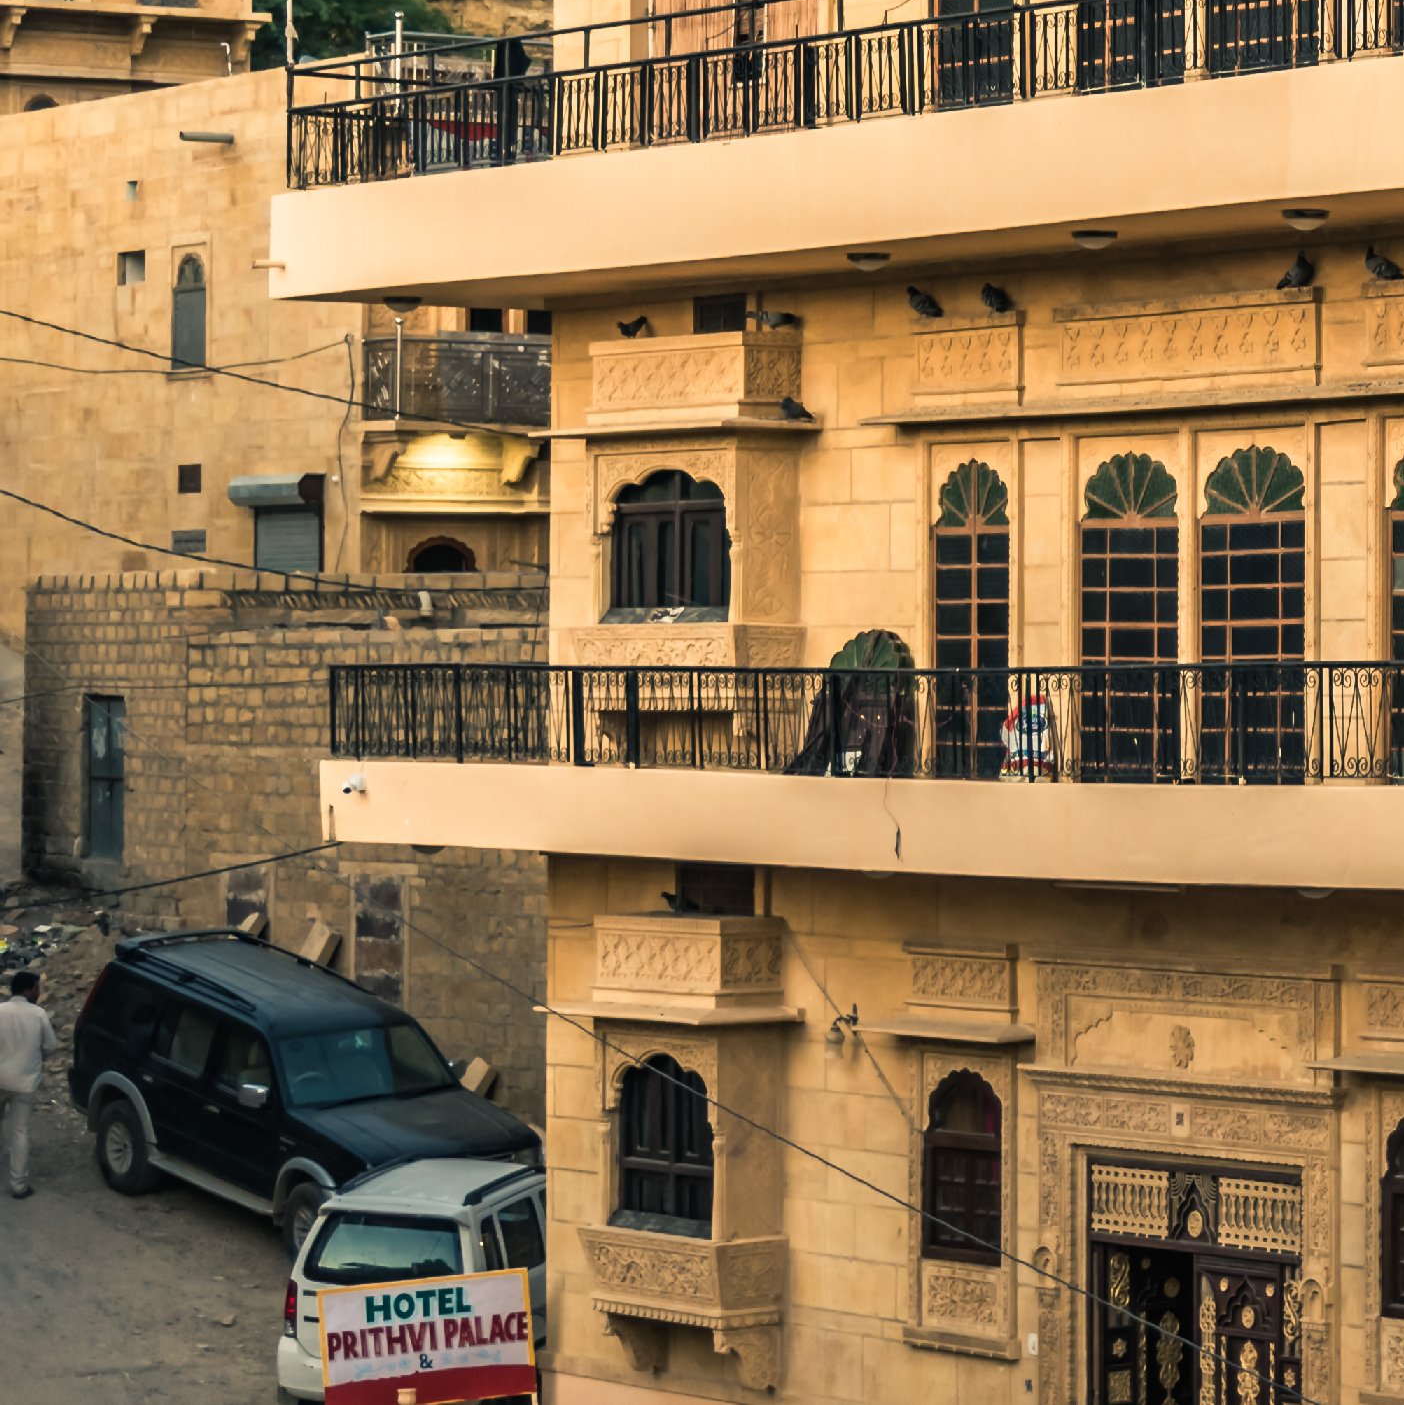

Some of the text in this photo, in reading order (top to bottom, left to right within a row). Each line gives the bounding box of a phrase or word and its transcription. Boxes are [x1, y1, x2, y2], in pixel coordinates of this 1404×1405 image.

[365, 1287, 471, 1323] HOTEL
[327, 1311, 529, 1362] PRITHVI PALACE
[419, 1353, 433, 1369] &
